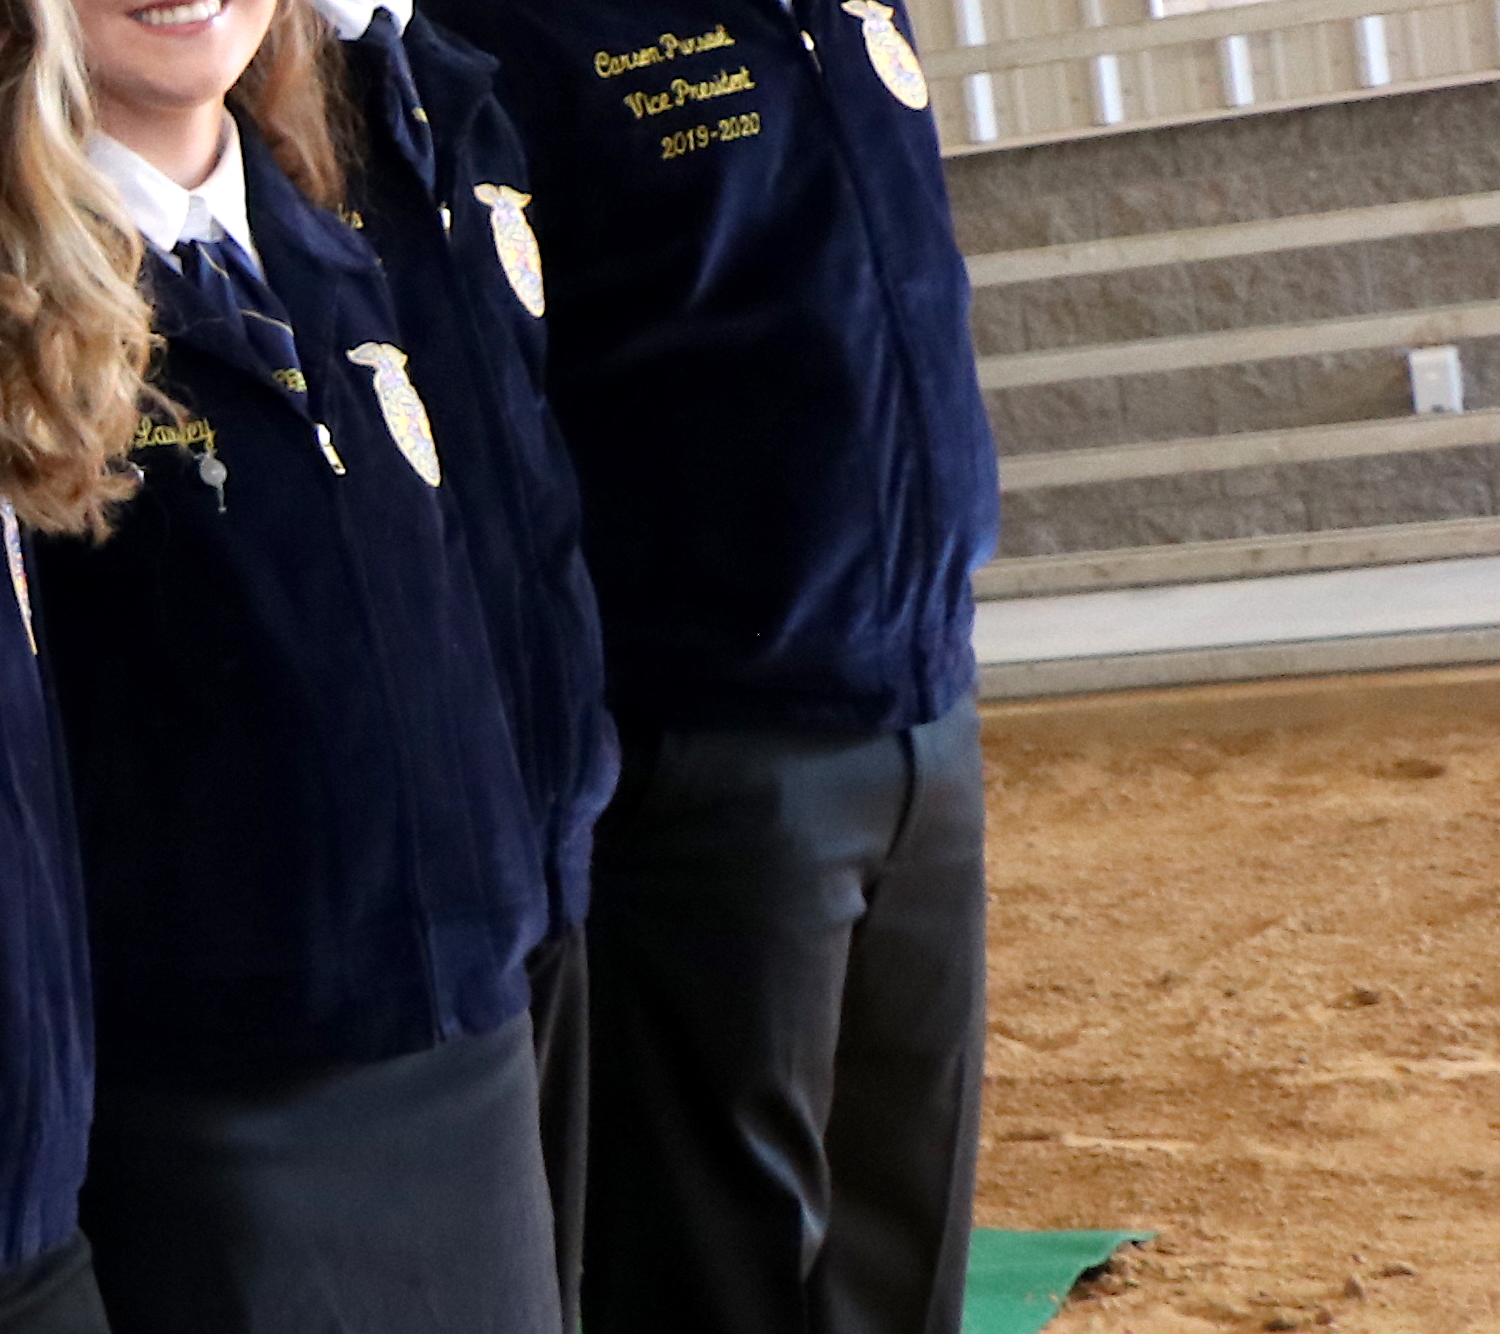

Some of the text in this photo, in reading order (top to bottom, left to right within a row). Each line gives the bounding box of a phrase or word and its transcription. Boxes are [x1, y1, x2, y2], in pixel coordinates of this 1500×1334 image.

[623, 66, 756, 119] Vice President
[661, 112, 761, 160] 2019-2020
